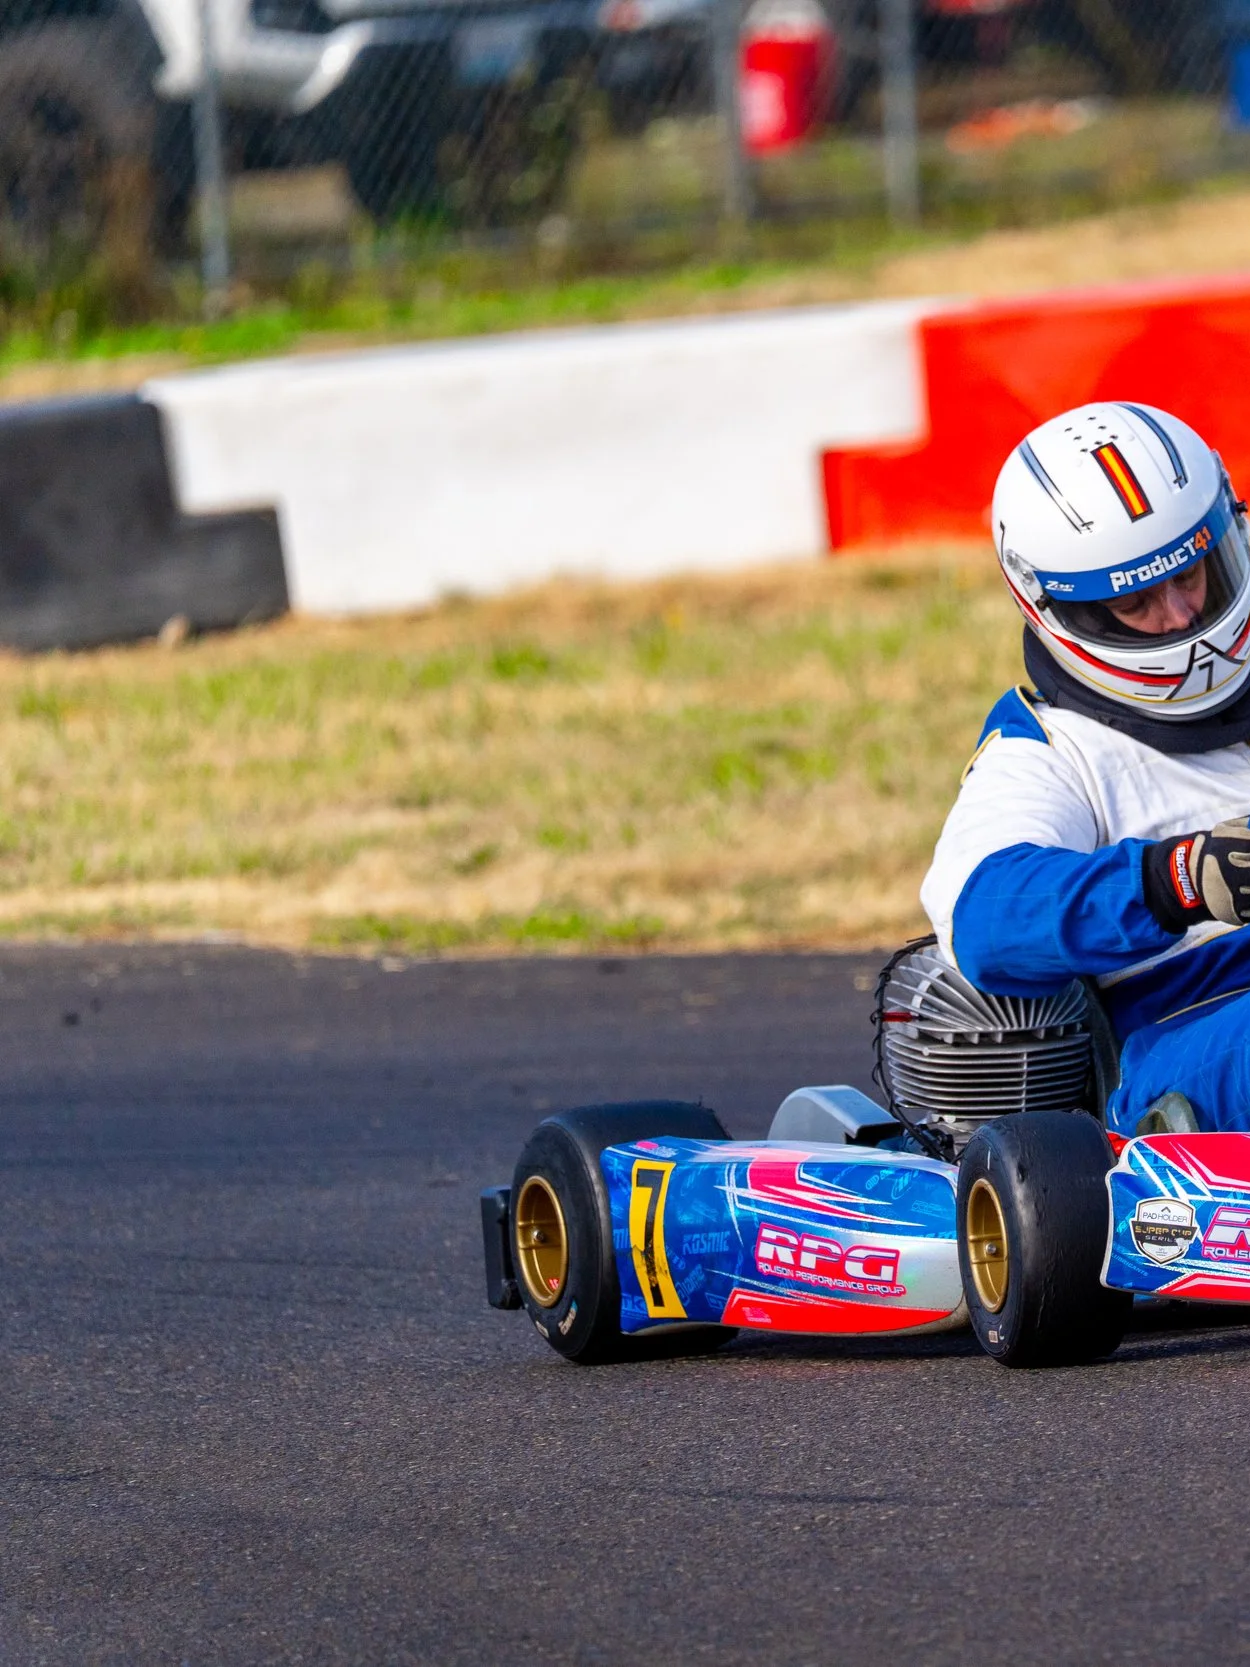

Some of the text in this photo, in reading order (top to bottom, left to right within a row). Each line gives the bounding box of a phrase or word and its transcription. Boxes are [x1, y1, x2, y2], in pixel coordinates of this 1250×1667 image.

[636, 1168, 667, 1307] 7
[758, 1227, 897, 1282] RPG
[796, 1271, 864, 1291] PERFORMANCE
[866, 1283, 905, 1295] GROUP
